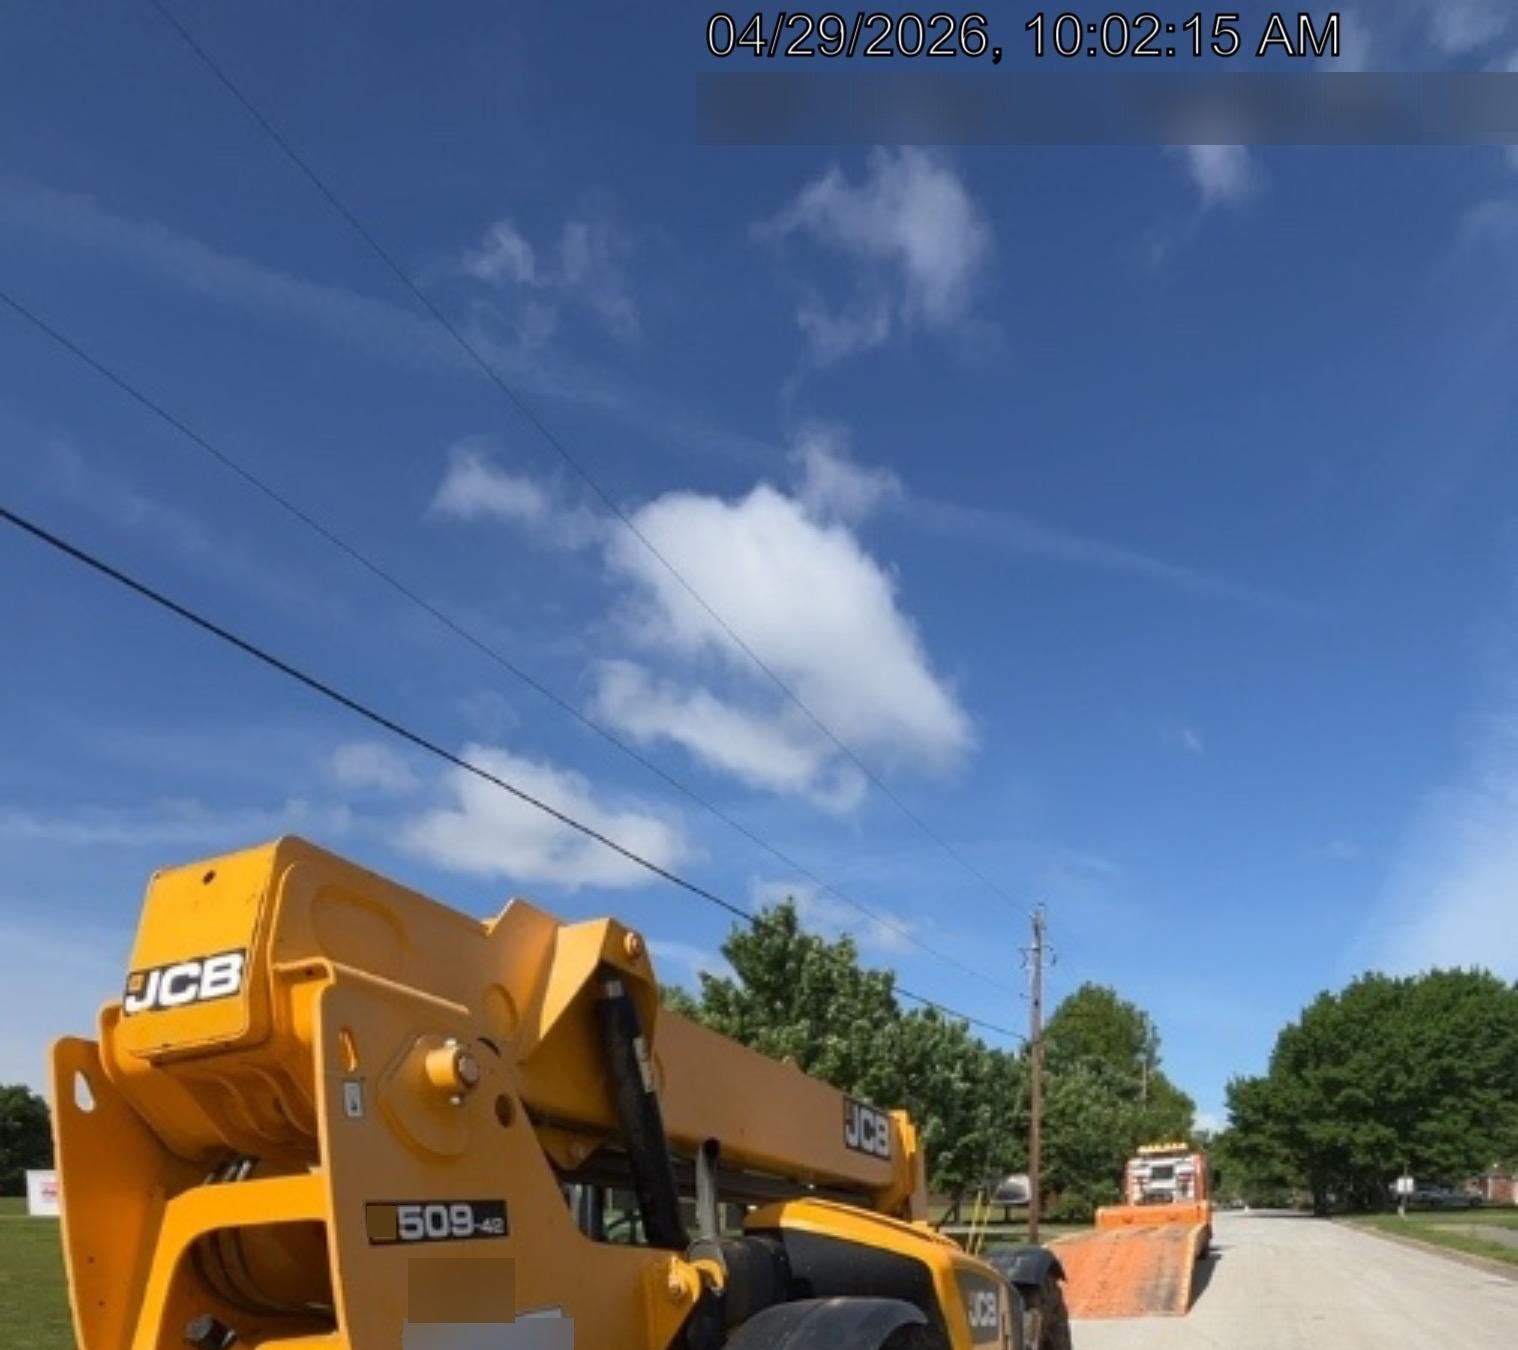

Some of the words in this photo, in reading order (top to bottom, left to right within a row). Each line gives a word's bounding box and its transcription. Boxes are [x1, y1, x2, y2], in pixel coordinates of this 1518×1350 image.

[124, 952, 245, 1013] JCB
[845, 1103, 889, 1157] JCB
[397, 1203, 505, 1240] 509-42
[969, 1291, 998, 1328] JCB
